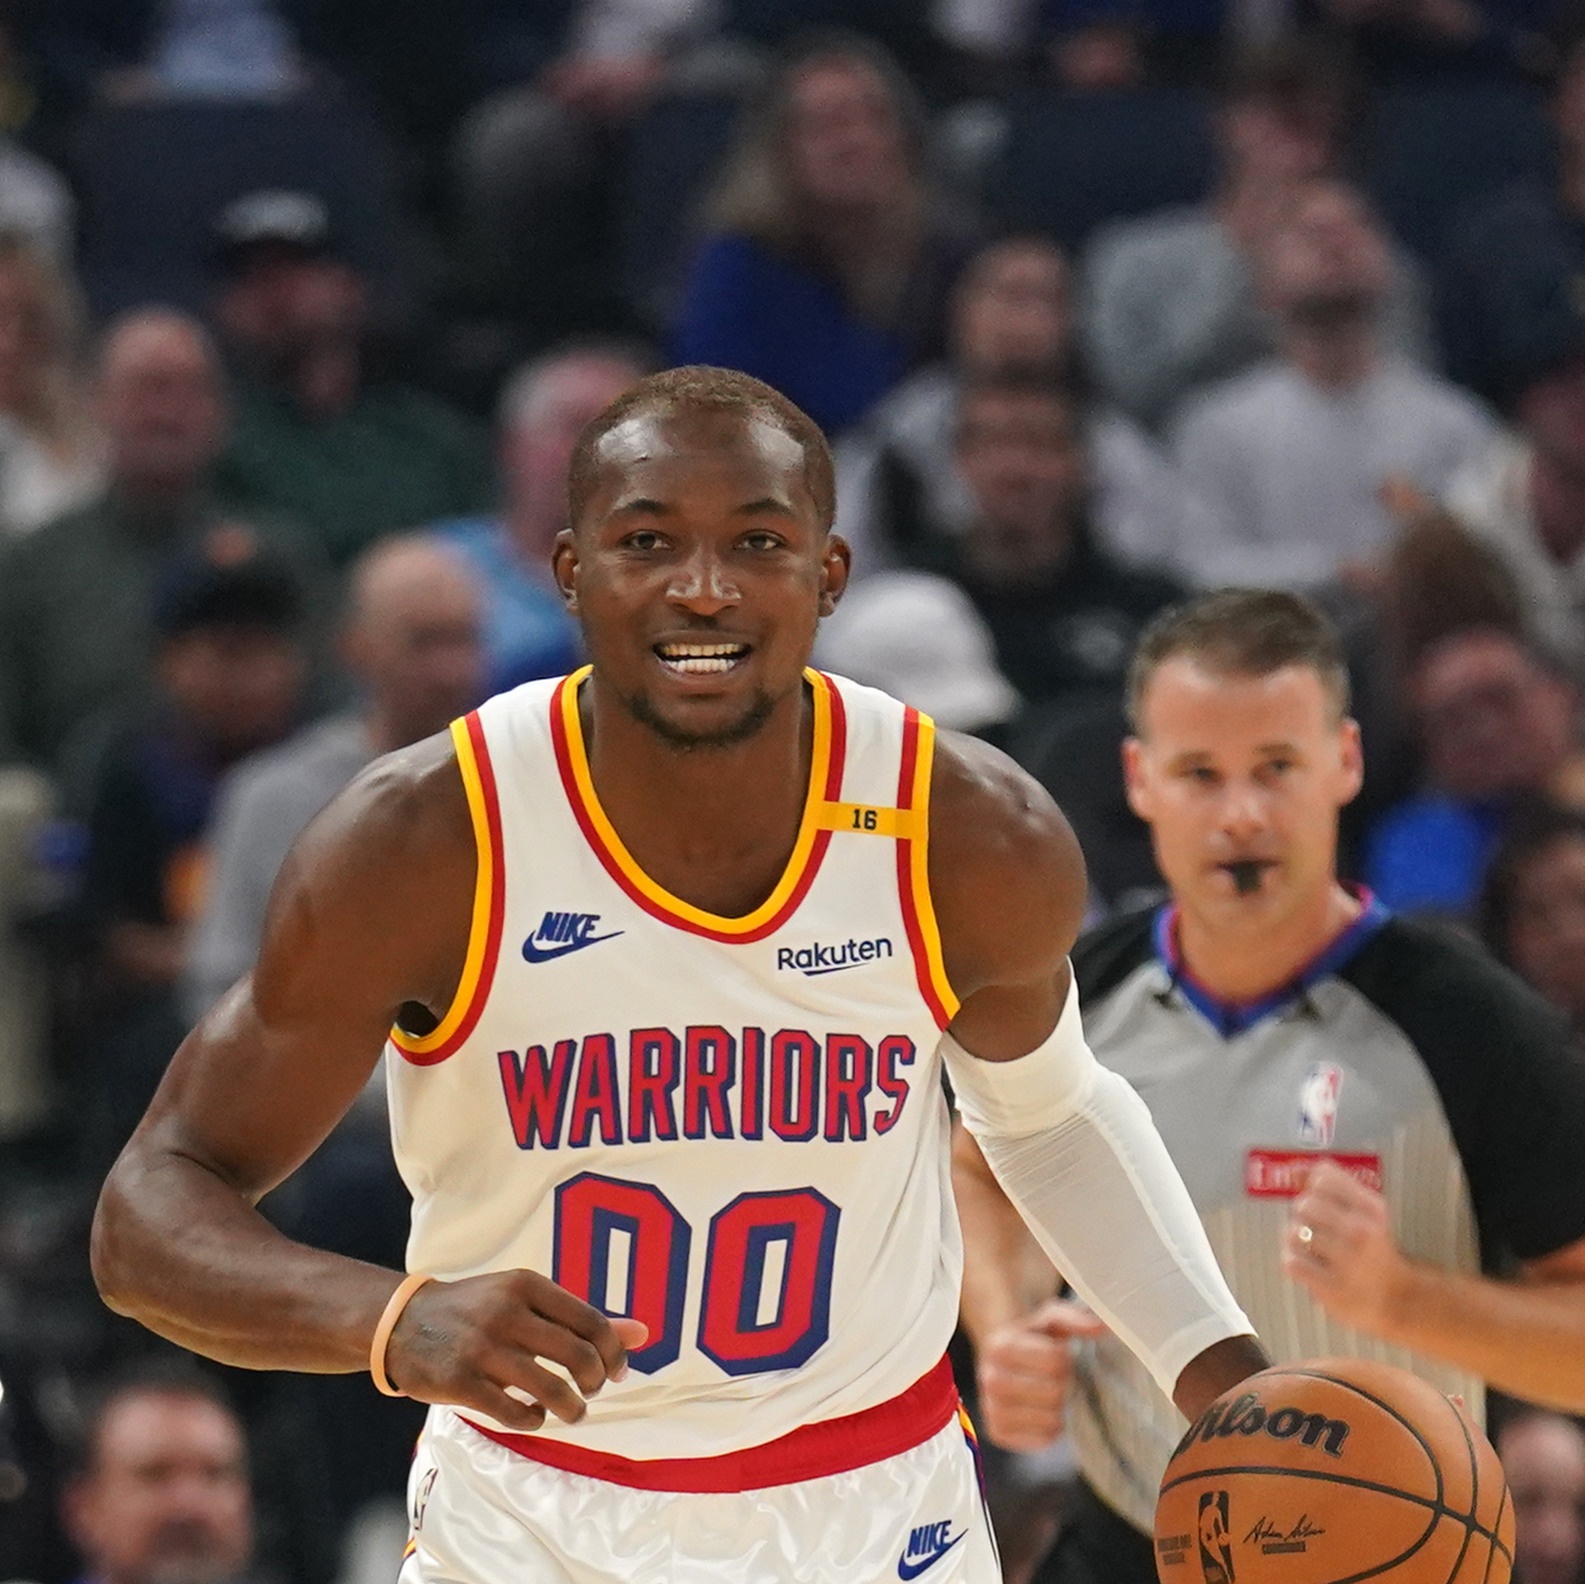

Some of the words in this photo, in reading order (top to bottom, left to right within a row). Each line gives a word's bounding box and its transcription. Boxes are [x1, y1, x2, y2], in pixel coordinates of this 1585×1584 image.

[851, 808, 878, 831] 16
[535, 912, 601, 943] NIKE
[777, 937, 893, 971] Rakuten
[497, 1025, 917, 1150] WARRIORS
[552, 1171, 843, 1377] 00
[906, 1519, 953, 1558] NIKE
